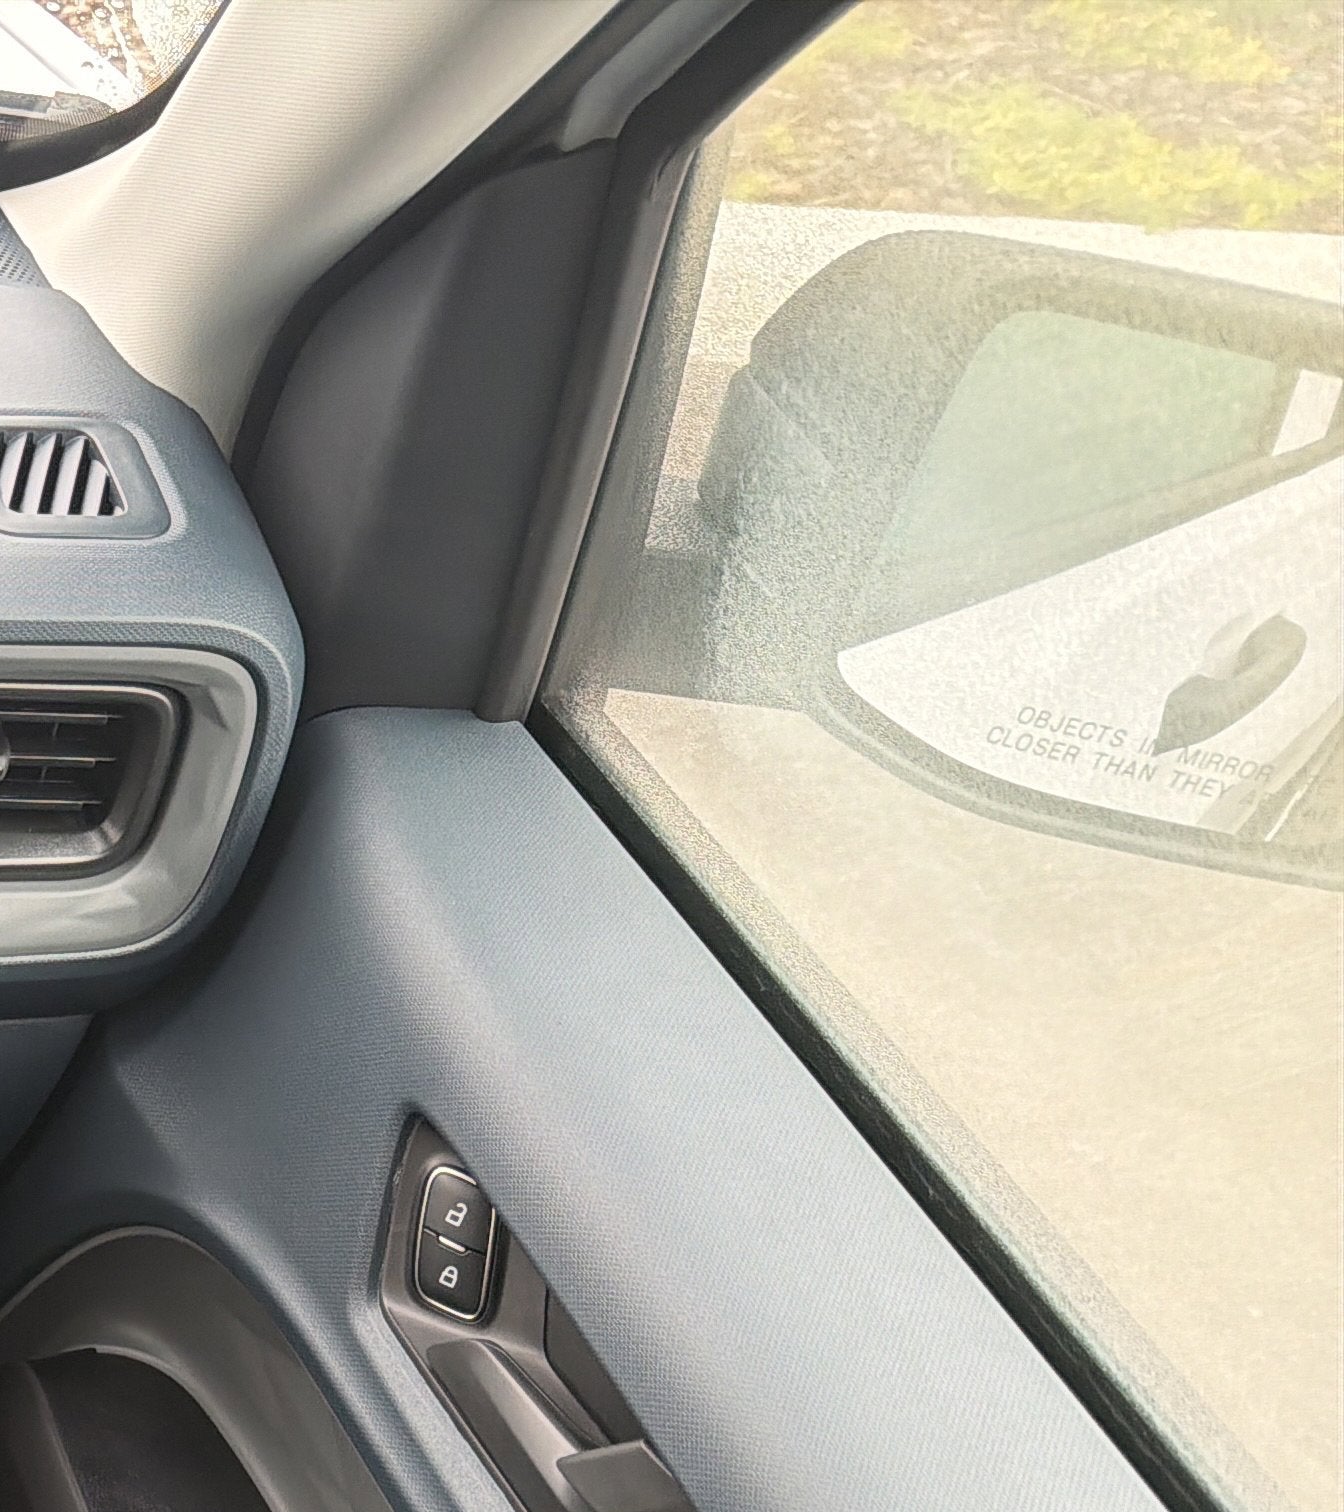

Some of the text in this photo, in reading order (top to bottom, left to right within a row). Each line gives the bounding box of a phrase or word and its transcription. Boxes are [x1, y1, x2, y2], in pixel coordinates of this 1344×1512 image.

[985, 725, 1081, 763] CLOSER
[1091, 751, 1156, 783] THAN
[1015, 706, 1128, 748] OBJECTS
[1177, 746, 1275, 782] MIRROR
